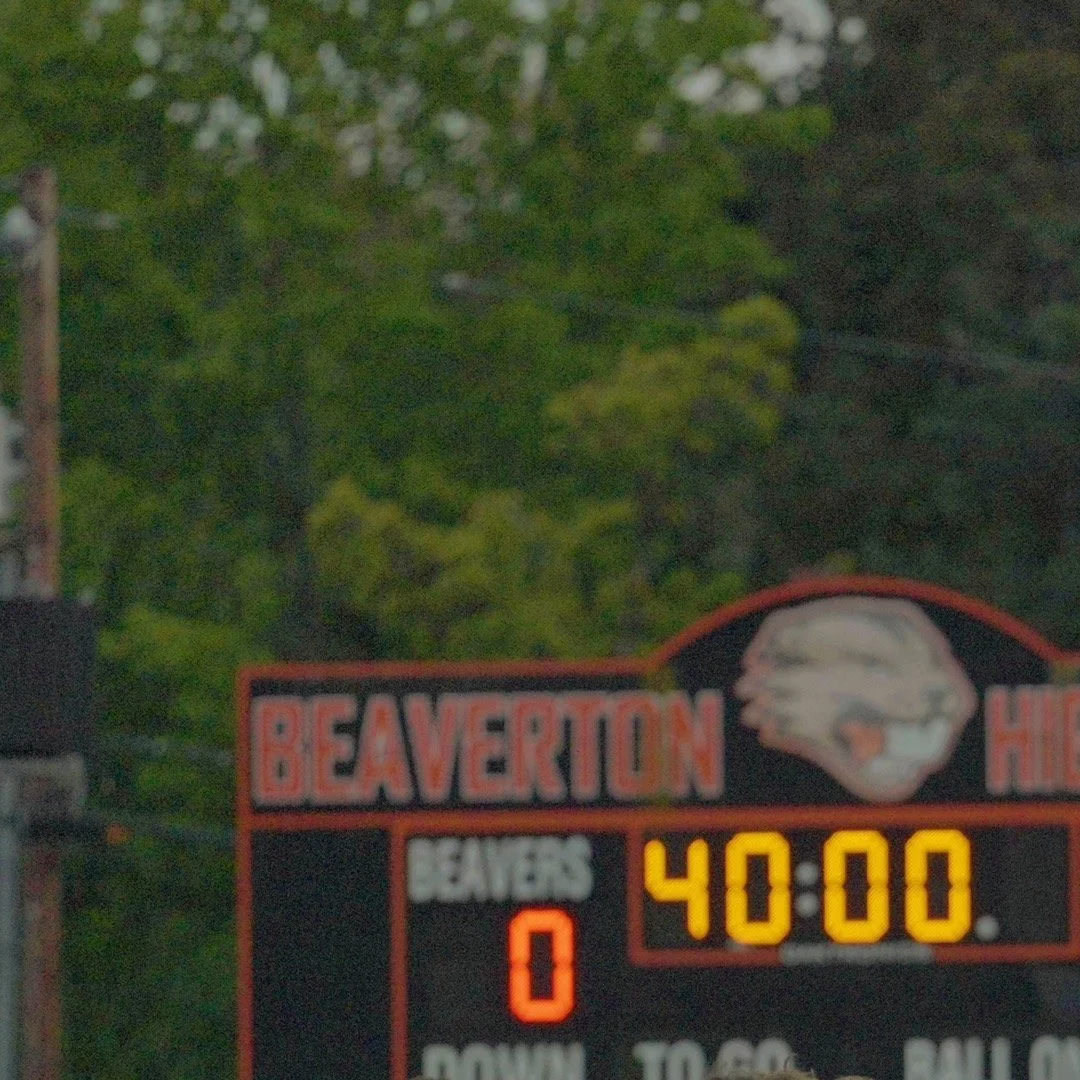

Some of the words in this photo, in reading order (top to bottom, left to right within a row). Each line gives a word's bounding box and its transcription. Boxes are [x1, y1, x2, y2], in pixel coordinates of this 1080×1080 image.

[252, 690, 724, 806] BEAVERTON
[407, 835, 594, 905] BEAVERS
[644, 829, 971, 946] 40:00
[508, 908, 575, 1024] 0
